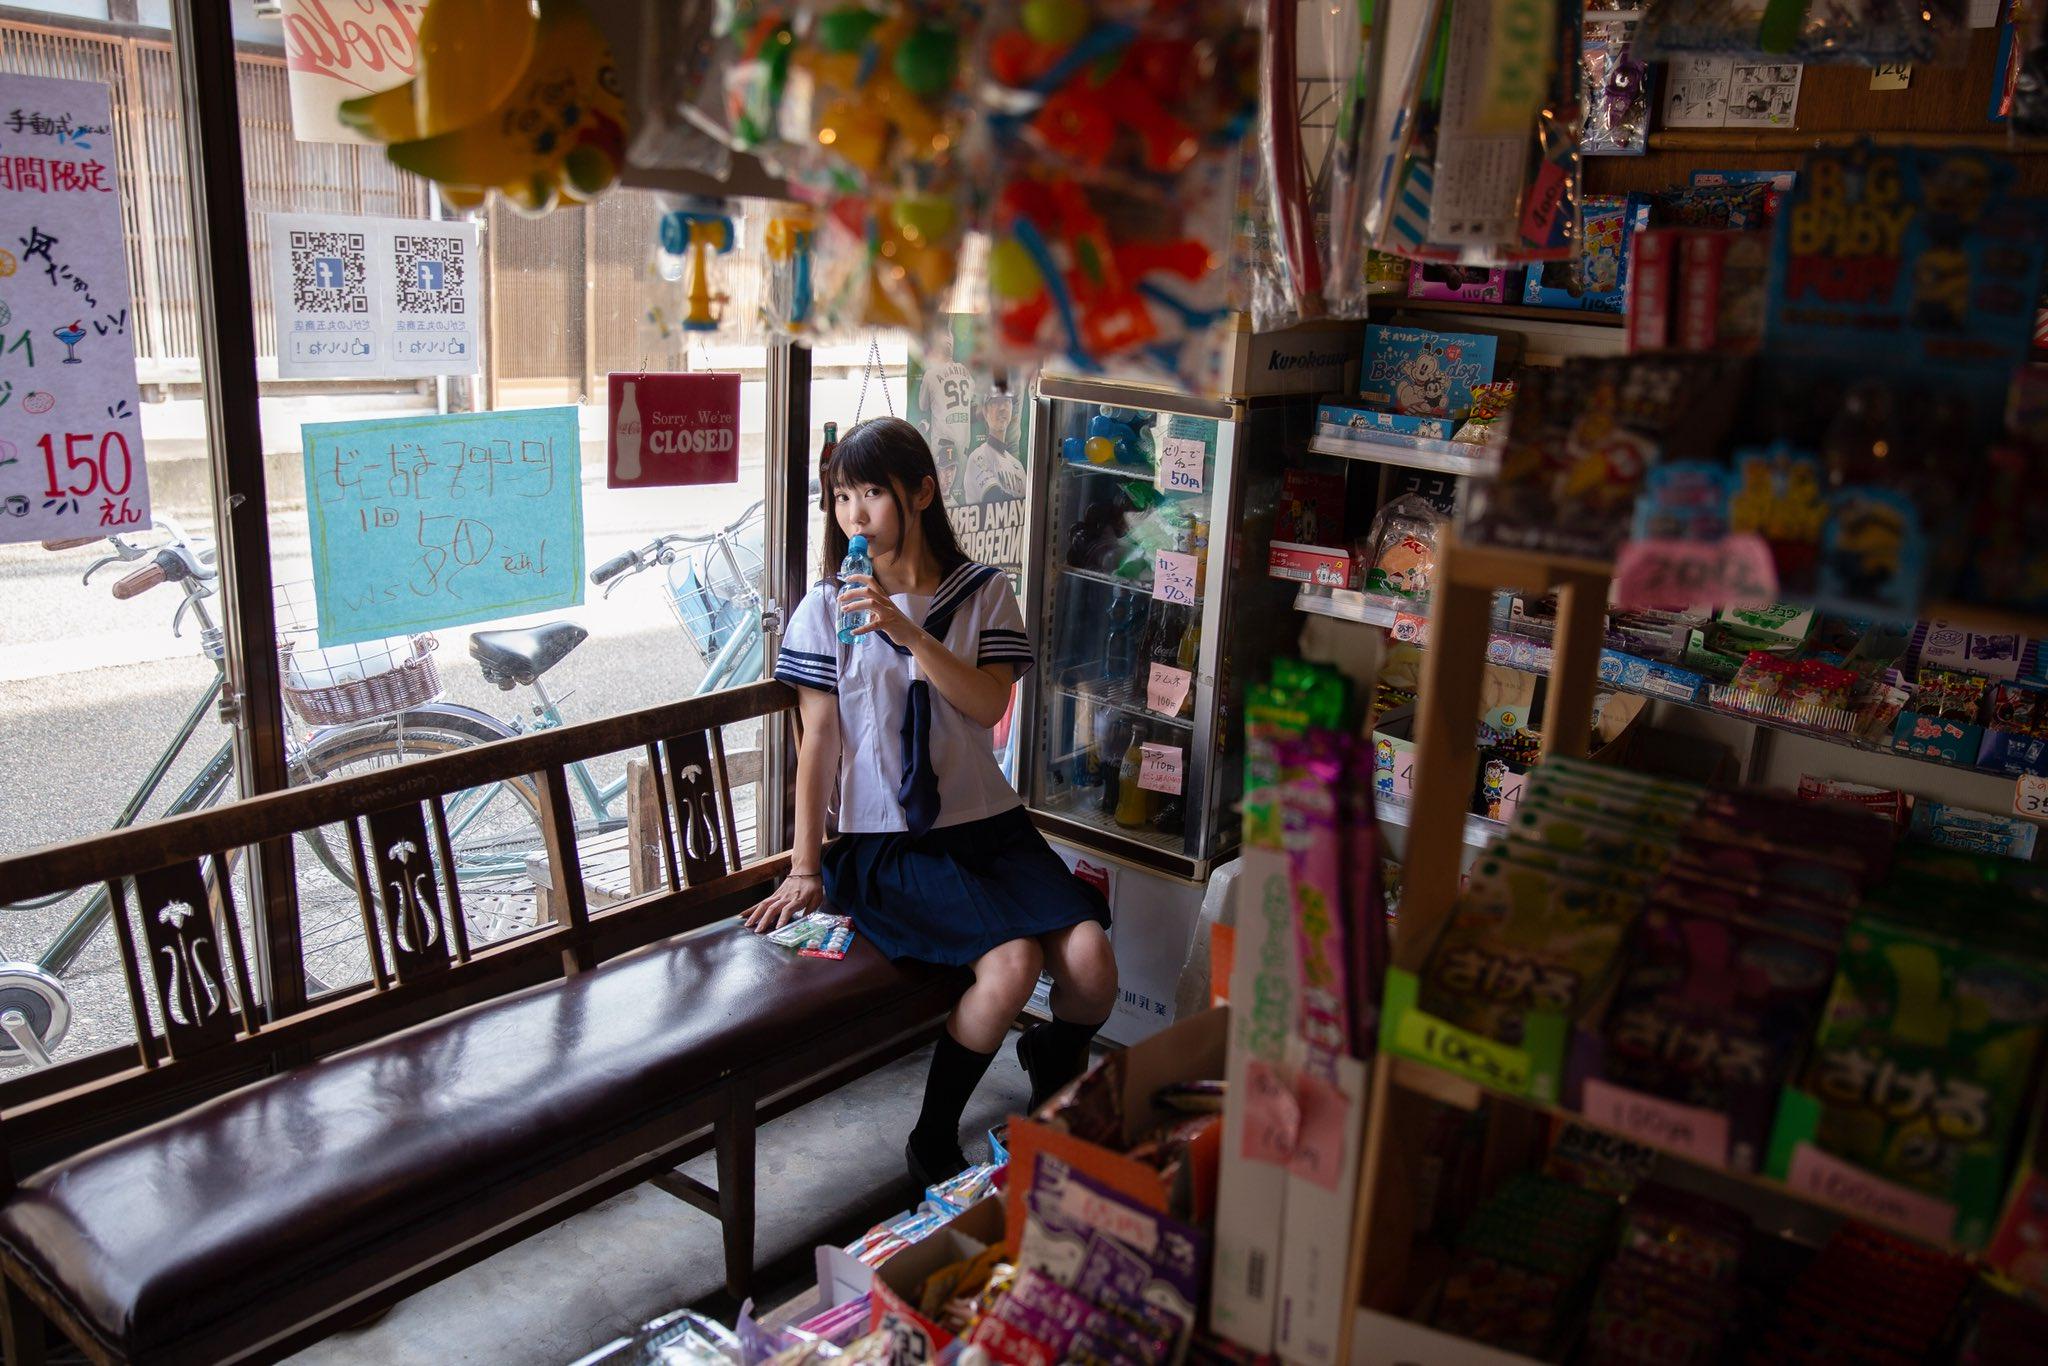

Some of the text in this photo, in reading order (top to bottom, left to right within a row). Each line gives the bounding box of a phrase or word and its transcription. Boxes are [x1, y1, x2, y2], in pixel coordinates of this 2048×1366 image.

[4, 109, 72, 137] 手動式
[698, 408, 732, 425] We're
[648, 428, 735, 455] CLOSED
[36, 430, 132, 498] 150
[1170, 470, 1201, 489] 50円
[1406, 476, 1456, 497] ココ
[99, 498, 142, 527] えん
[1159, 558, 1179, 572] カン
[1154, 672, 1181, 688] ラムネ
[1157, 694, 1177, 711] 100円
[1117, 988, 1167, 1016] 川乳業
